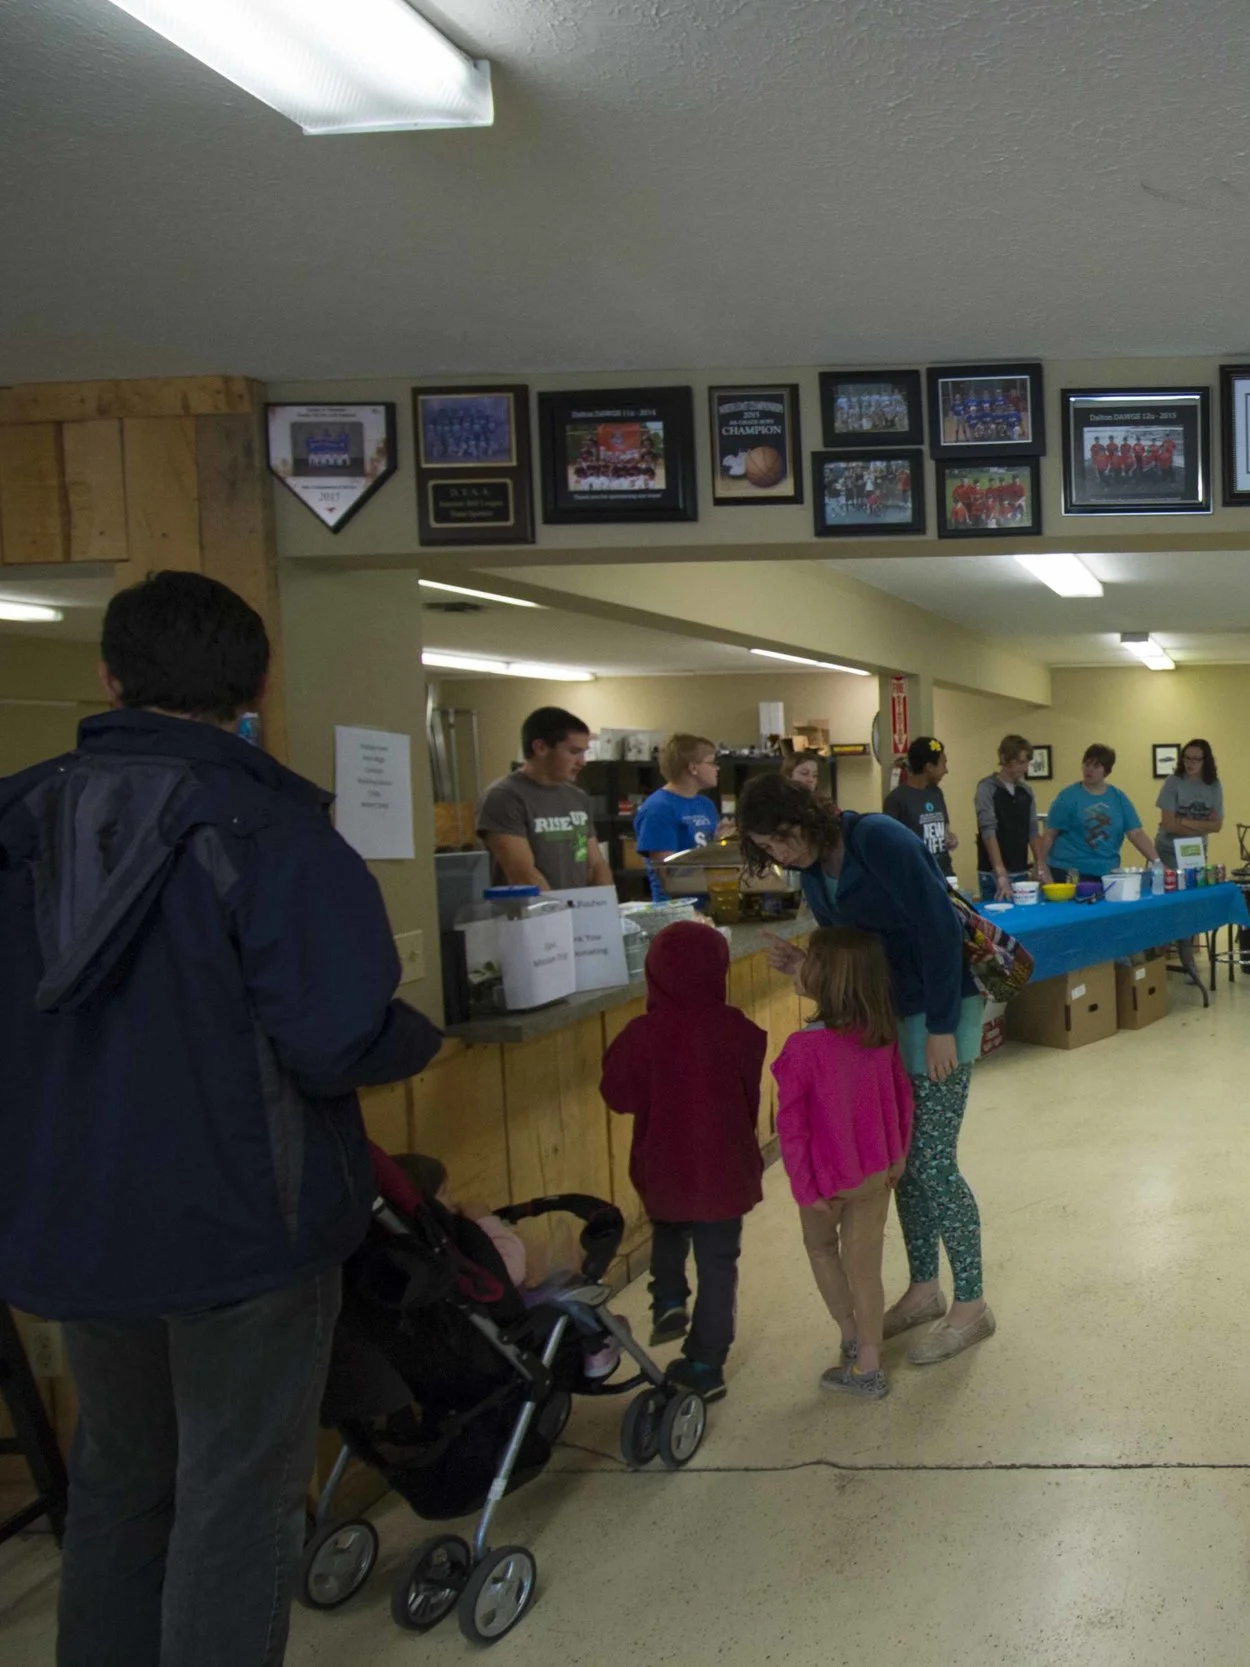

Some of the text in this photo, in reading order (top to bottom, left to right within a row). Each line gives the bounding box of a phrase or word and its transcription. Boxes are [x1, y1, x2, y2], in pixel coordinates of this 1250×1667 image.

[721, 425, 782, 436] CHAMPION
[534, 811, 588, 833] RISE UP
[923, 821, 945, 838] NEW
